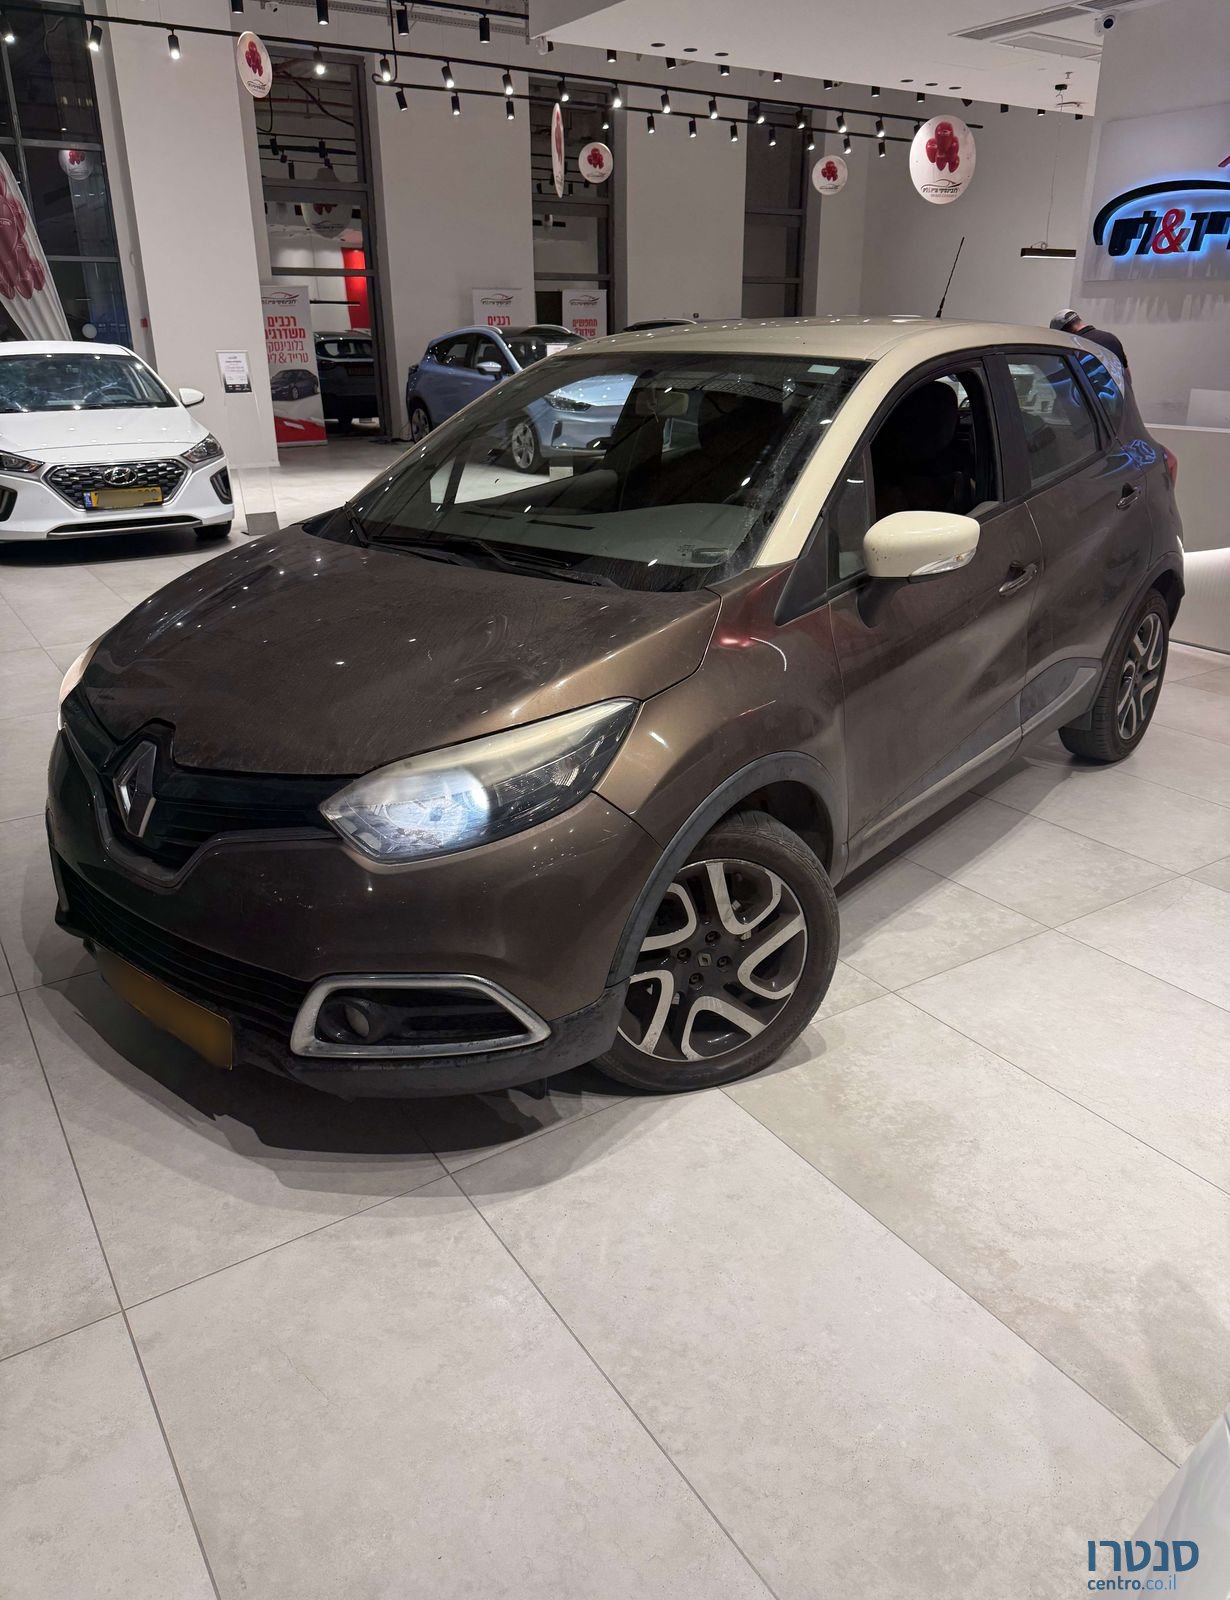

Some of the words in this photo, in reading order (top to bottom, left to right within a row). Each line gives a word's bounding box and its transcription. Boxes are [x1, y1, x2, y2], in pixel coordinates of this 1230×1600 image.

[1108, 208, 1230, 256] ייד&ליס
[267, 316, 297, 327] רכבים
[488, 316, 511, 326] רכבים
[266, 340, 305, 352] בלובינסק
